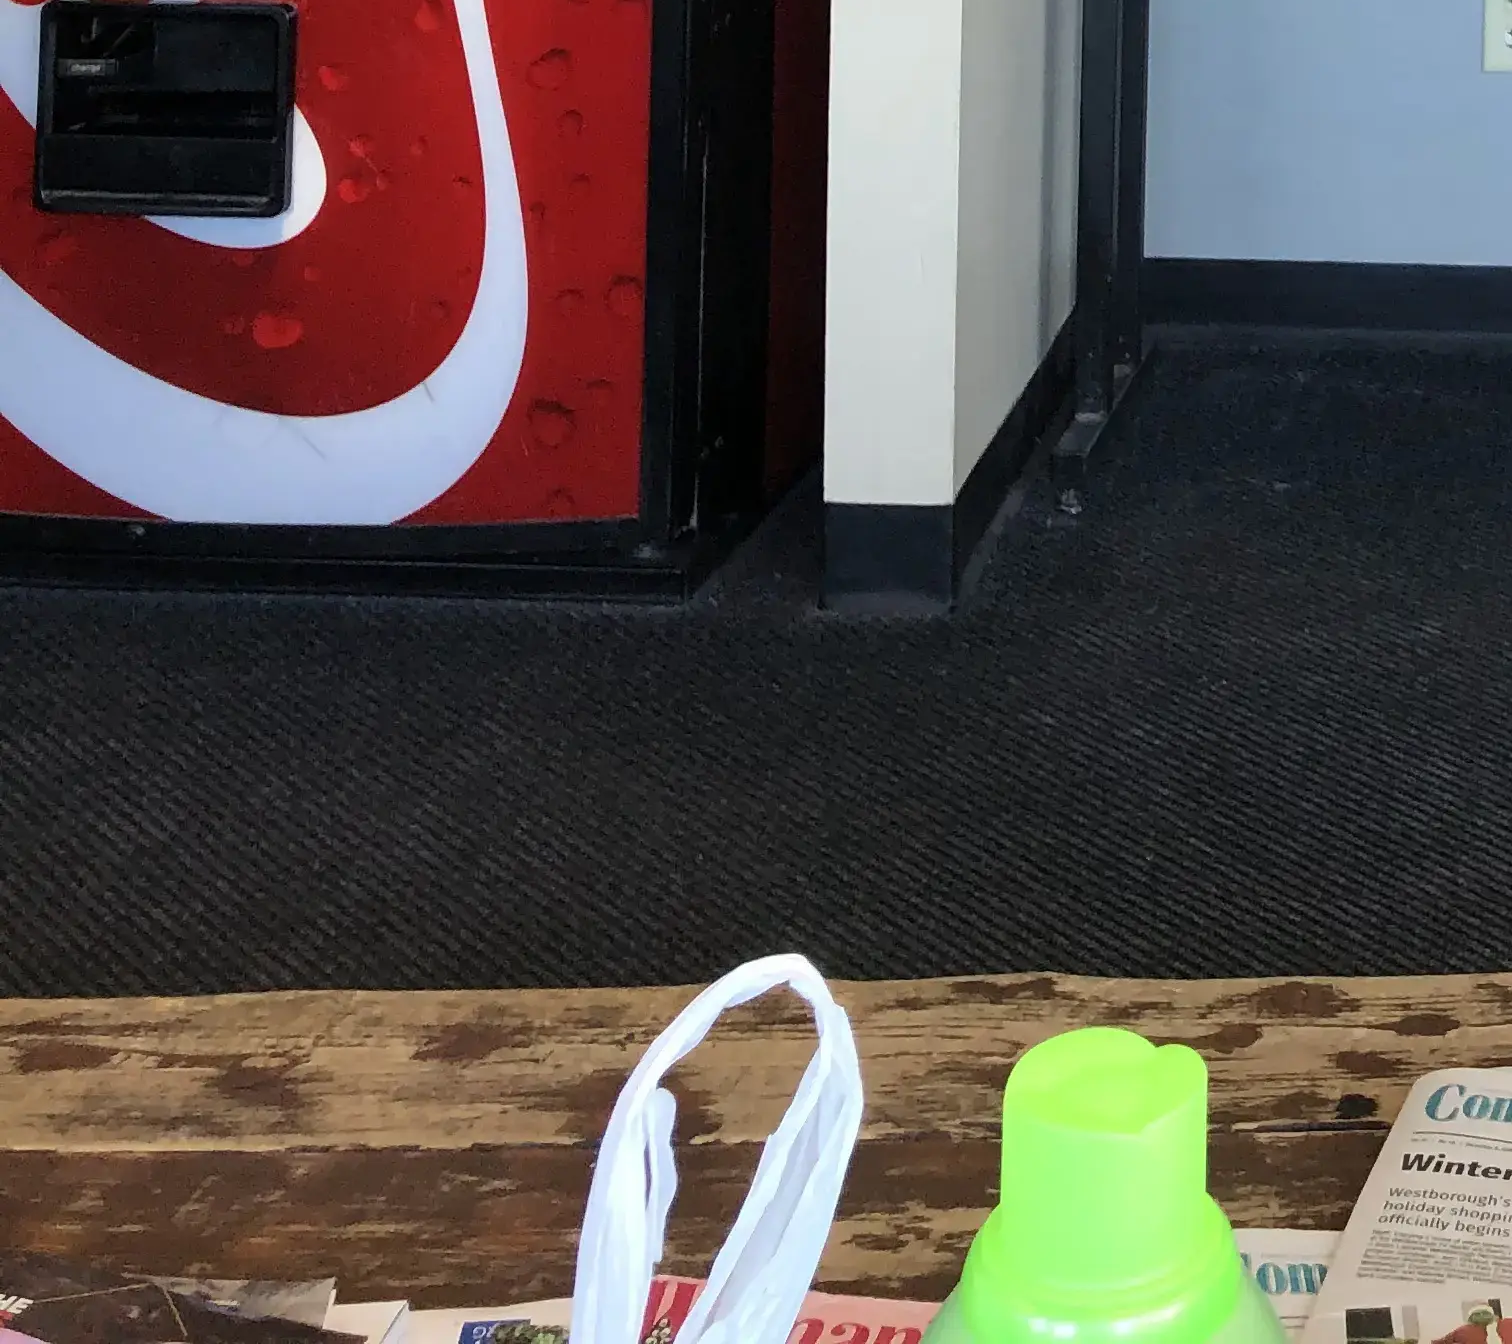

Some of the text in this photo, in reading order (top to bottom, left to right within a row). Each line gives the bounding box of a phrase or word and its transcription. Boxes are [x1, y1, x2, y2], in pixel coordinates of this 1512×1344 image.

[1383, 1201, 1446, 1215] holiday
[1389, 1187, 1512, 1208] Westborough's
[1378, 1214, 1511, 1237] officially begins
